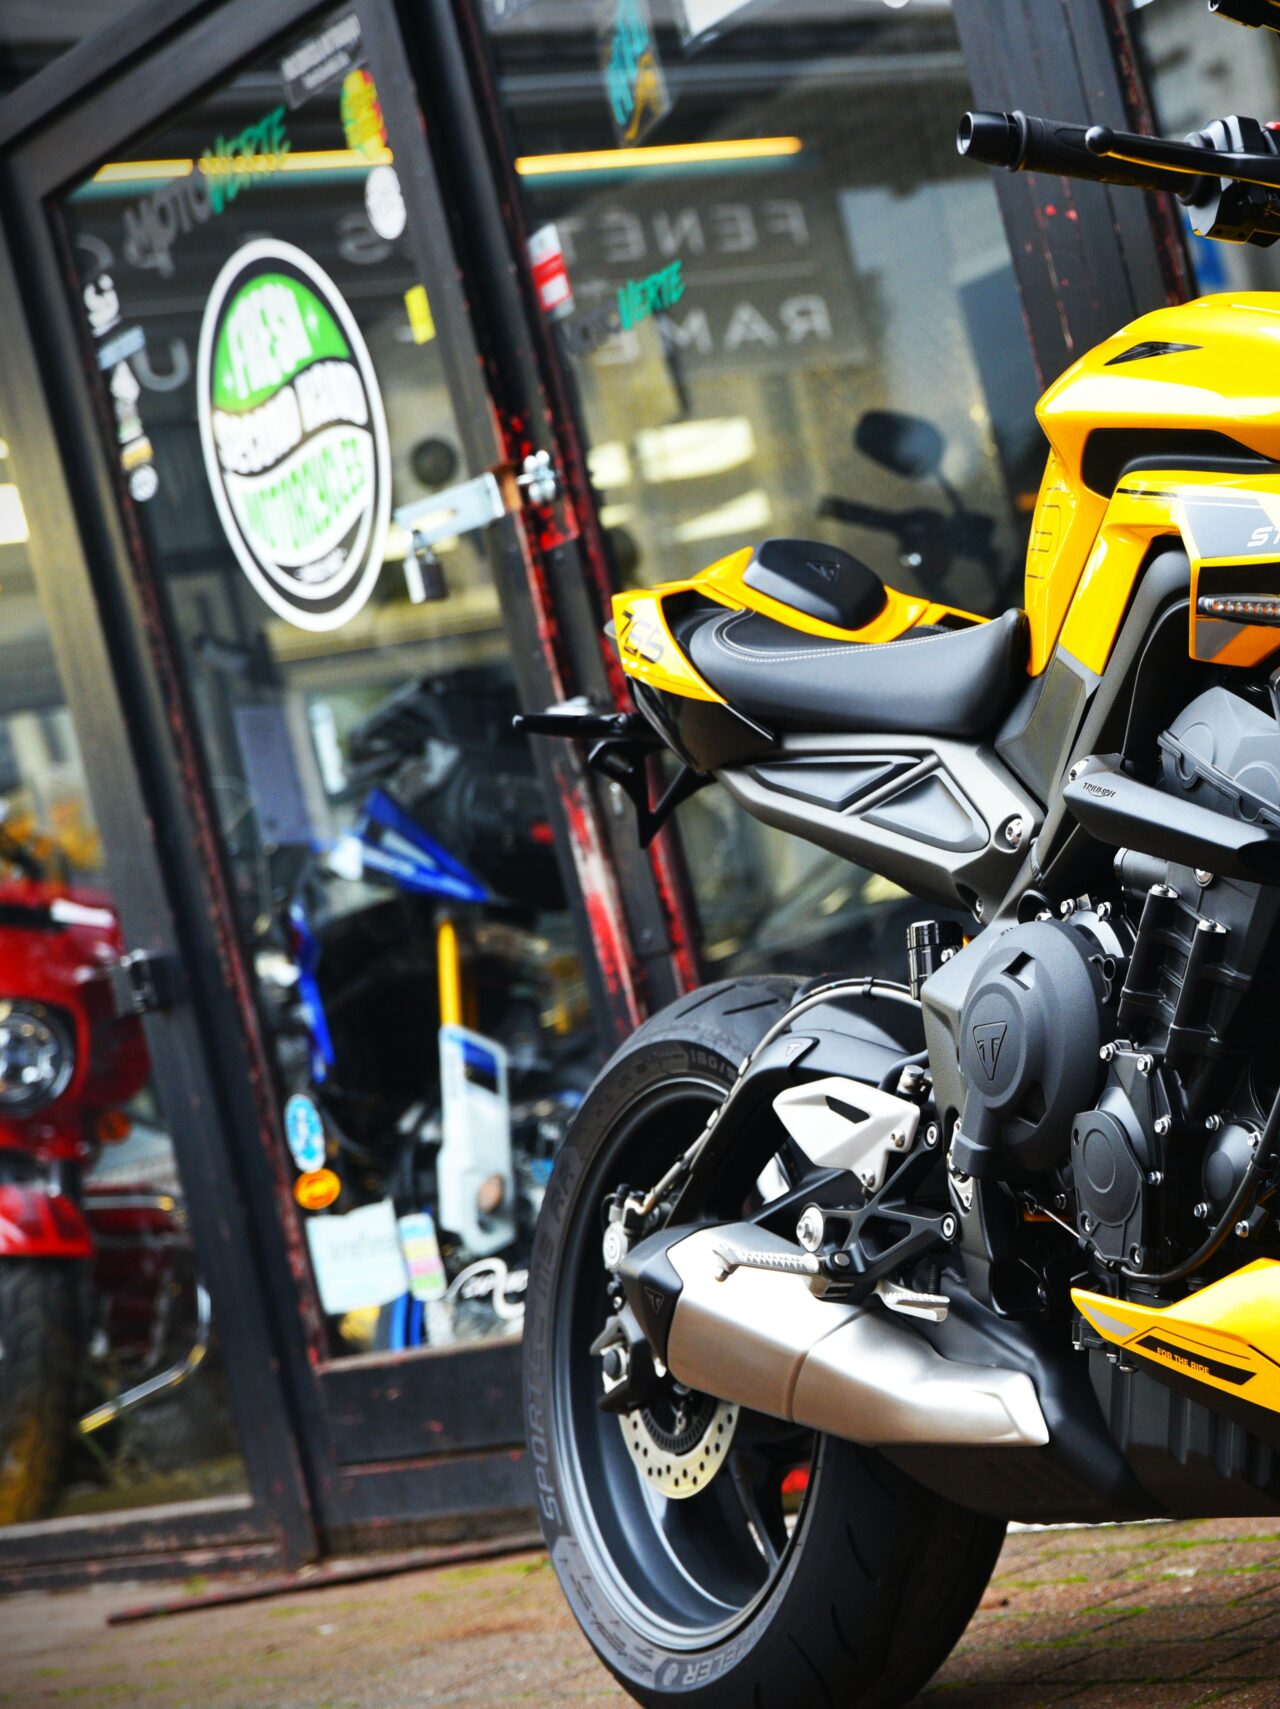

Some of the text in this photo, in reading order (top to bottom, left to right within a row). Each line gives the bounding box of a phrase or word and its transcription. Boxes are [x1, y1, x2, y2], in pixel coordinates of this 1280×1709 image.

[1082, 782, 1117, 798] TRIUMPH
[1157, 1347, 1210, 1375] FOR THE RIDE
